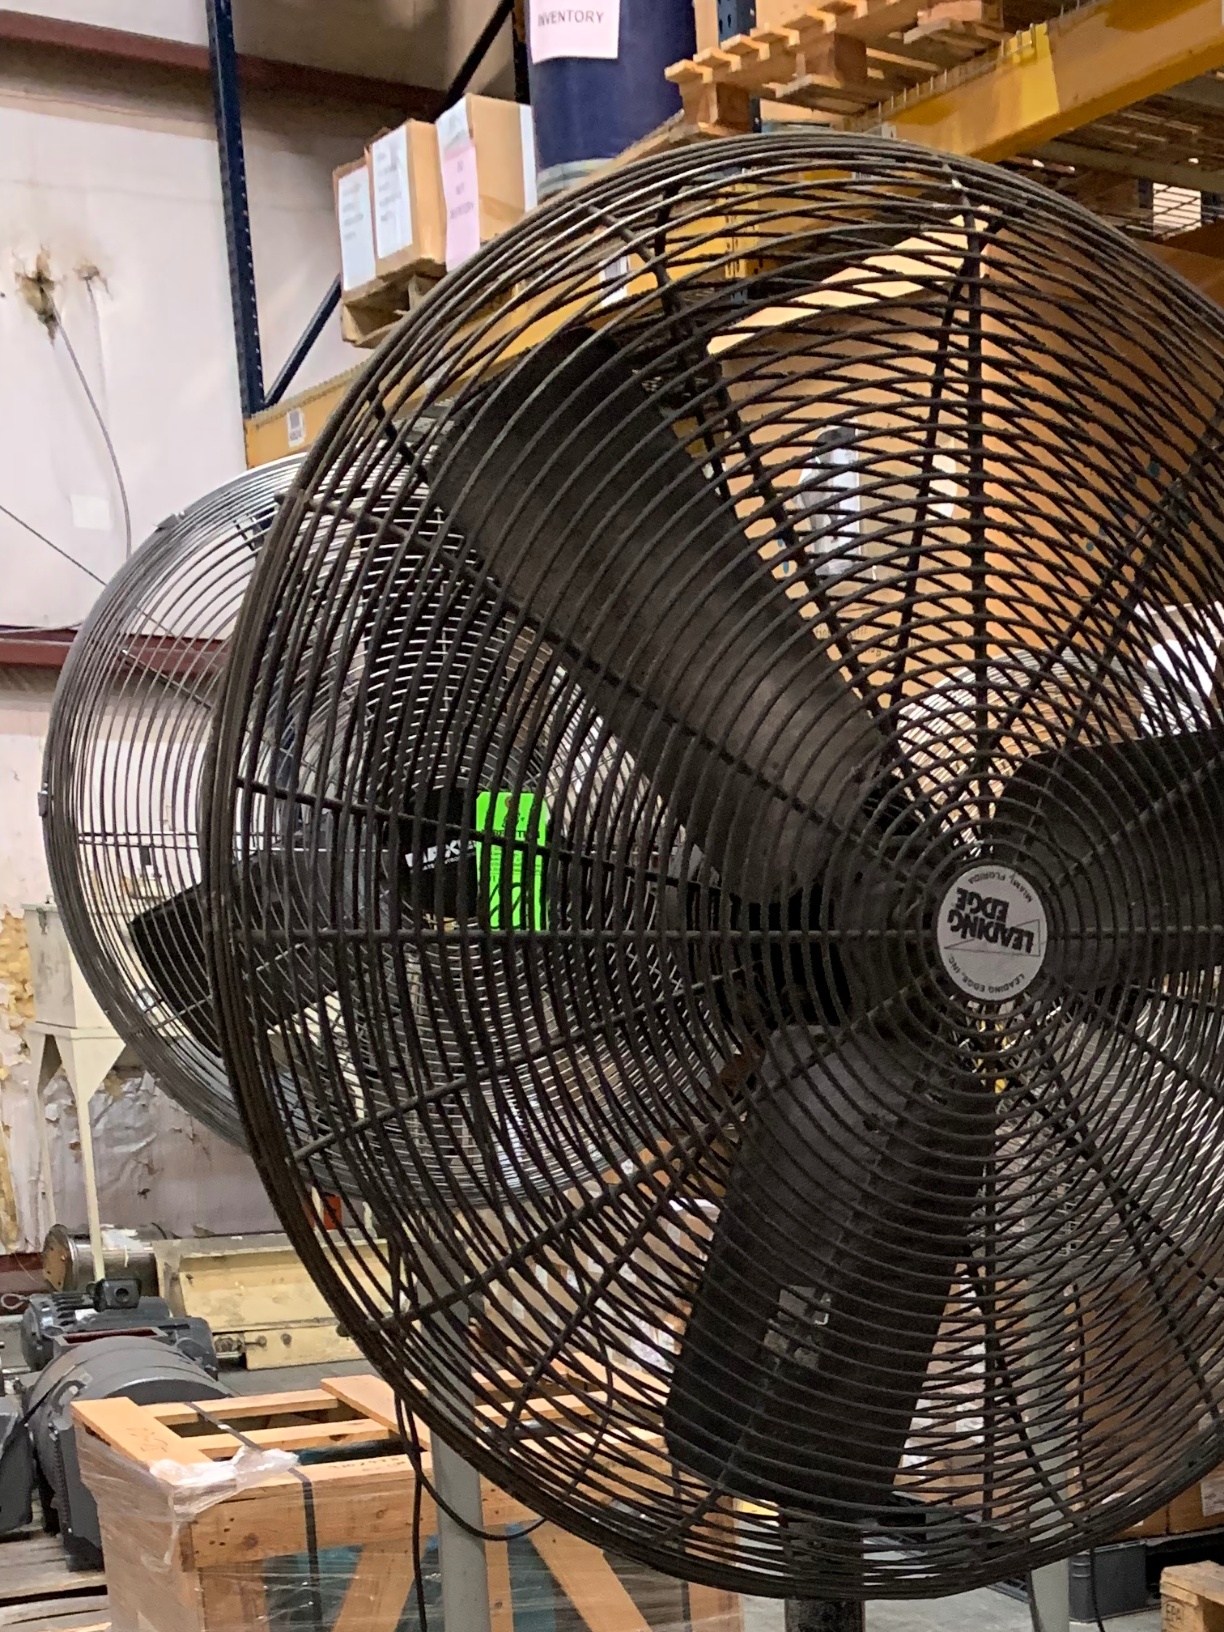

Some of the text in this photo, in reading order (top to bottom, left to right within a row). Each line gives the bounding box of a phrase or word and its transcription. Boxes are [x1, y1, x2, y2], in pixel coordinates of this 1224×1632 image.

[538, 9, 604, 27] INVENTORY
[967, 871, 1006, 885] FLORIDA
[955, 887, 1010, 923] EDGE
[946, 909, 1035, 954] LEADING
[988, 973, 1025, 994] LEADING
